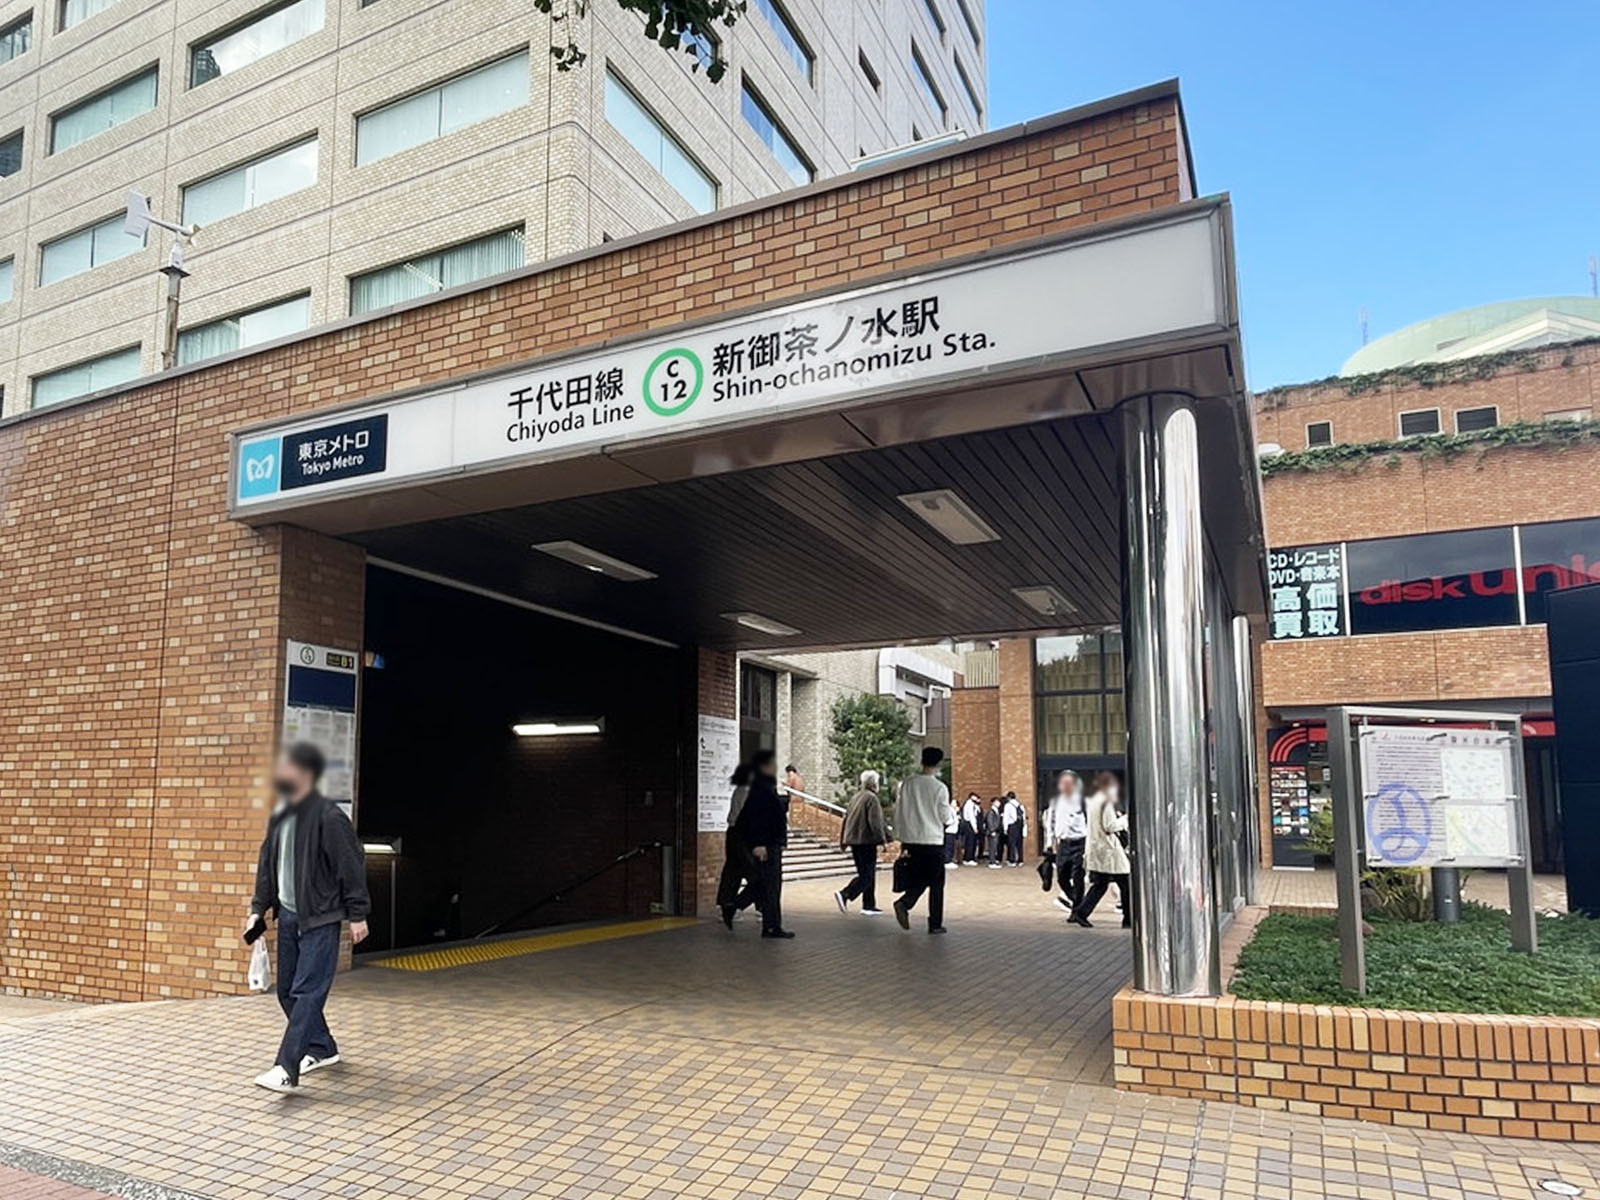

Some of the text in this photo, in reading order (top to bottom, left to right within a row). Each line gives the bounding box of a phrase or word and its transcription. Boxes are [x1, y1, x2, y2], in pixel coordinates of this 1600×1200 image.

[712, 296, 941, 379] 新御茶ノ水駅
[666, 360, 679, 378] C
[712, 332, 996, 402] Shin-ochanomizu Sta.
[507, 367, 624, 419] 千代田線
[661, 380, 687, 402] 12
[506, 404, 634, 442] Chiyoda Line
[298, 430, 369, 461] 東京メトロ
[302, 454, 364, 476] Tokyo Metro
[1360, 575, 1465, 605] disk
